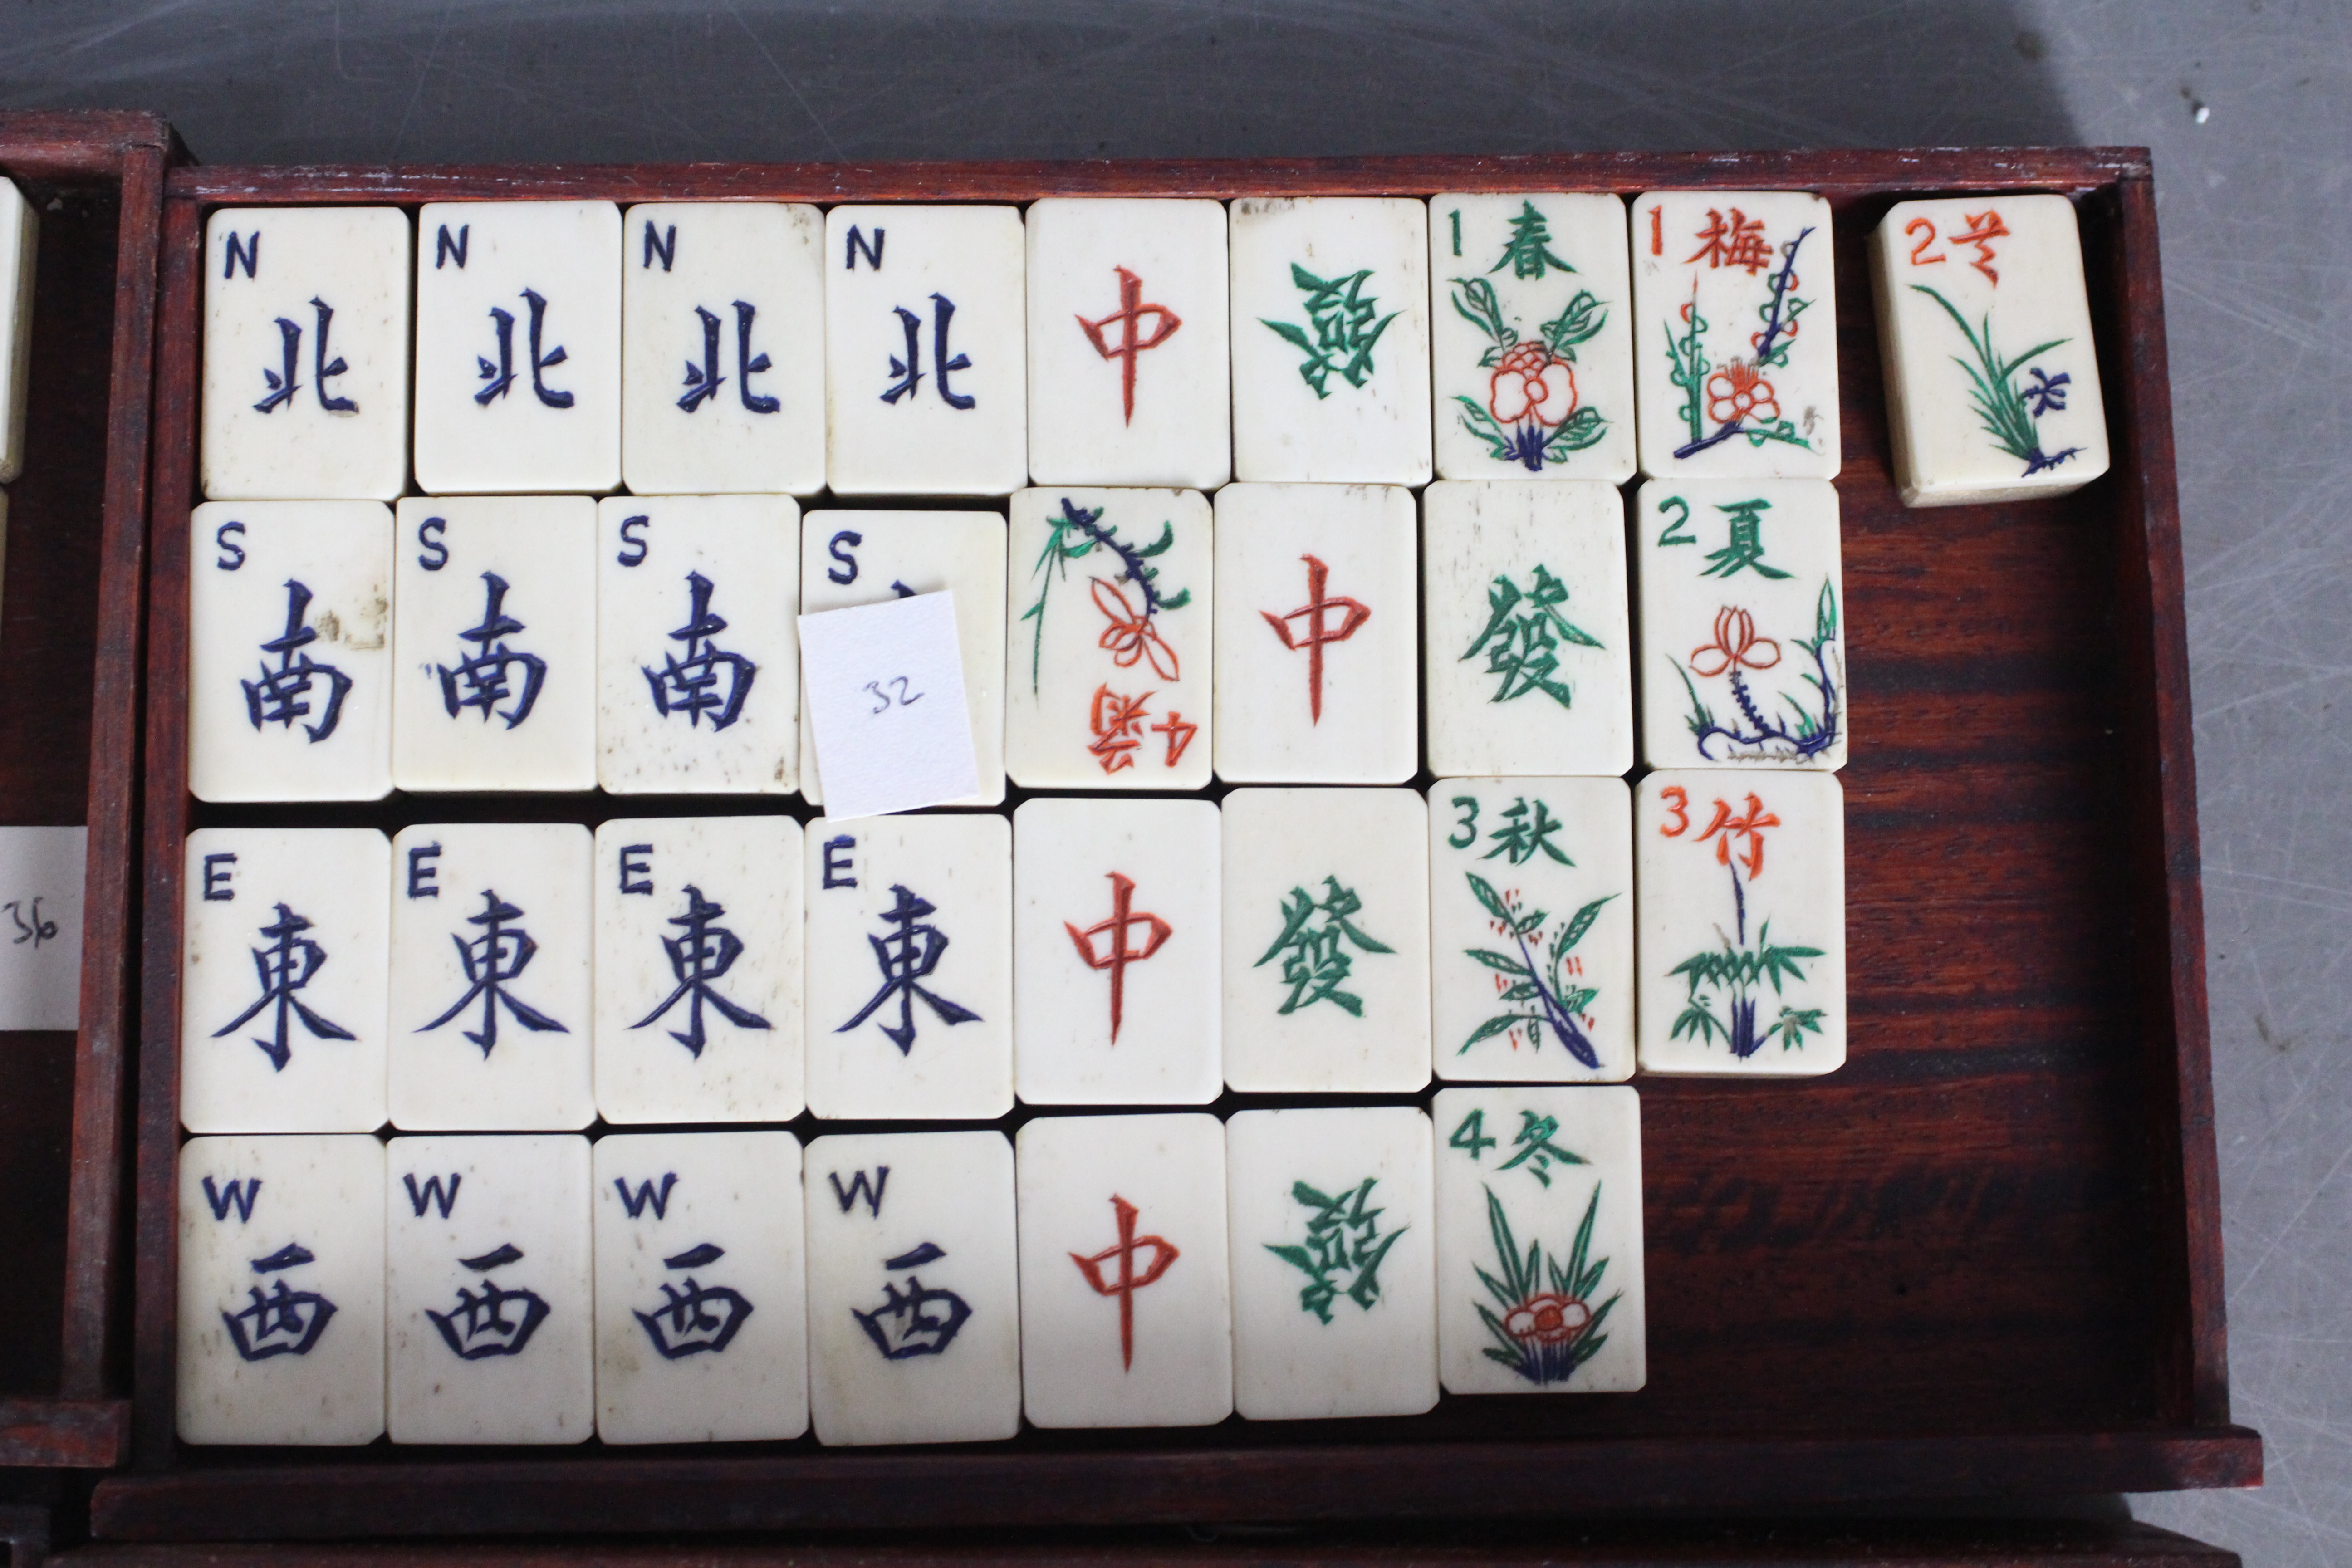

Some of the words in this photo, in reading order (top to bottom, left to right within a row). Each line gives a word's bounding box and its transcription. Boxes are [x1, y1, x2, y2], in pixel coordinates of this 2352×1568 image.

[224, 231, 260, 280] N
[436, 224, 469, 270] N
[643, 220, 676, 273] N
[846, 224, 885, 271] N
[1448, 209, 1462, 257] 1
[1486, 199, 1577, 281] 春
[1648, 205, 1663, 256] 1
[1684, 207, 1774, 277] 梅
[1905, 217, 1946, 266] 2
[252, 295, 359, 417] 北
[474, 287, 575, 409] 北
[676, 299, 780, 414] 北
[879, 292, 976, 410] 北
[1075, 265, 1182, 428] 中
[1258, 262, 1401, 400] 發
[216, 521, 246, 571] S
[418, 517, 449, 571] S
[617, 515, 650, 567] S
[828, 530, 862, 585] S
[1657, 495, 1697, 547] 2
[1699, 498, 1794, 580] 夏
[240, 578, 353, 744] 南
[436, 571, 548, 730] 南
[641, 570, 760, 732] 南
[1260, 554, 1371, 726] 中
[1458, 563, 1605, 710] 發
[862, 676, 925, 715] 32
[1151, 711, 1198, 768] 4
[407, 842, 442, 899] E
[618, 844, 654, 896] E
[823, 835, 858, 890] E
[1448, 796, 1480, 849] 3
[1483, 796, 1575, 867] 秋
[1660, 786, 1689, 838] 3
[1694, 792, 1781, 881] 竹
[203, 853, 238, 901] E
[5, 897, 58, 949] 36
[1064, 871, 1173, 1045] 中
[1253, 875, 1396, 1018] 發
[211, 902, 357, 1073] 東
[414, 889, 570, 1061] 東
[622, 883, 775, 1061] 東
[832, 882, 984, 1058] 東
[1449, 1109, 1496, 1161] 4
[1497, 1109, 1590, 1189] 冬
[201, 1175, 263, 1224] W
[403, 1173, 461, 1220] W
[614, 1171, 679, 1221] W
[828, 1166, 890, 1219] W
[1068, 1194, 1180, 1375] 中
[1263, 1177, 1408, 1327] 發
[219, 1243, 339, 1367] 西
[424, 1243, 551, 1364] 西
[632, 1243, 755, 1366] 西
[850, 1242, 973, 1361] 西
